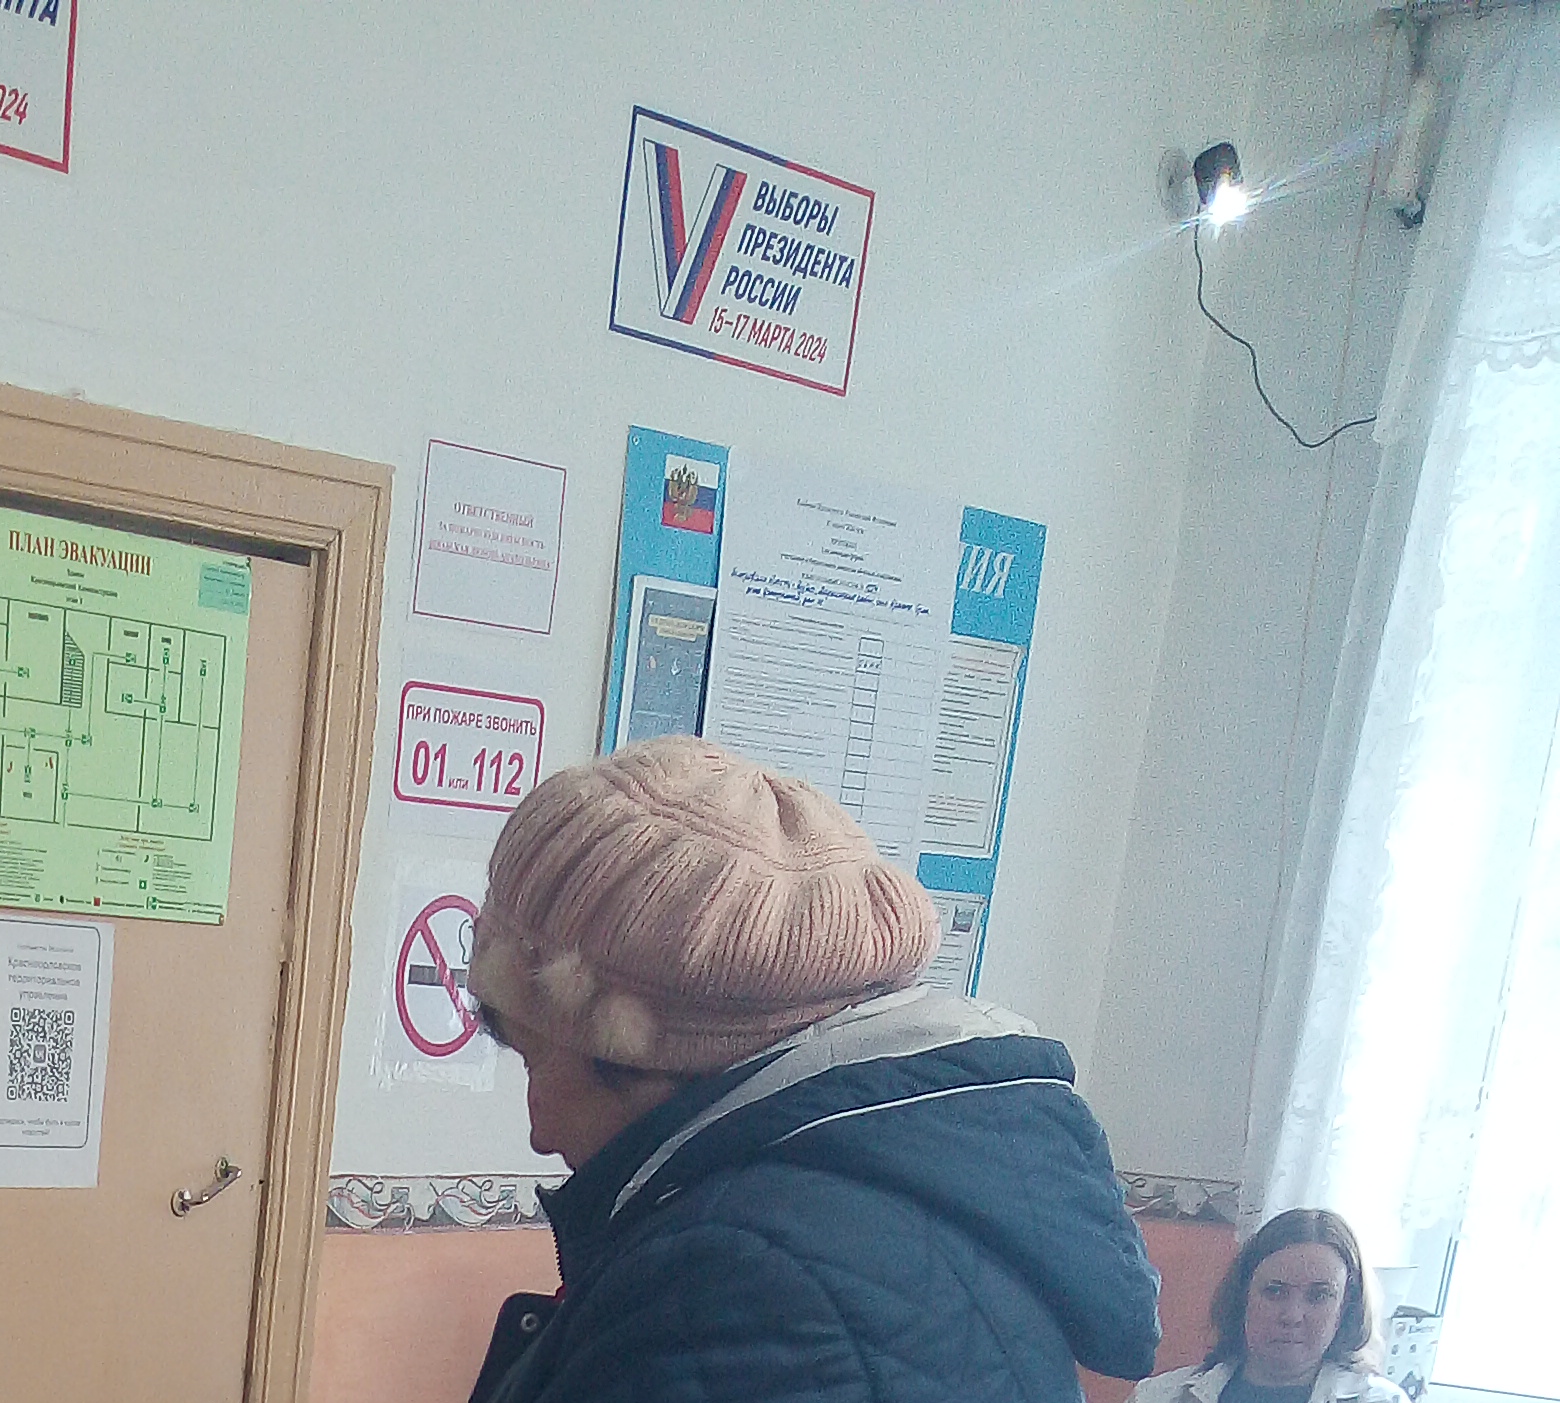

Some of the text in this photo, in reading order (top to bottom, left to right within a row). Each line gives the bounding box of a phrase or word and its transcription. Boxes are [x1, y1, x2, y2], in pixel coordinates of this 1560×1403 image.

[753, 181, 839, 236] ВЫБОРЫ
[737, 223, 855, 289] ПРЕЗИДЕНТА
[721, 266, 802, 316] РОССИИ
[749, 318, 793, 355] МАРТА
[794, 333, 828, 364] 2024
[9, 530, 151, 577] ПЛАН ЭВАКУАЦИИ
[406, 703, 537, 736] ПРИ ПОЖАРЕ ЗВОНИТЬ
[411, 740, 525, 796] 01 или 112
